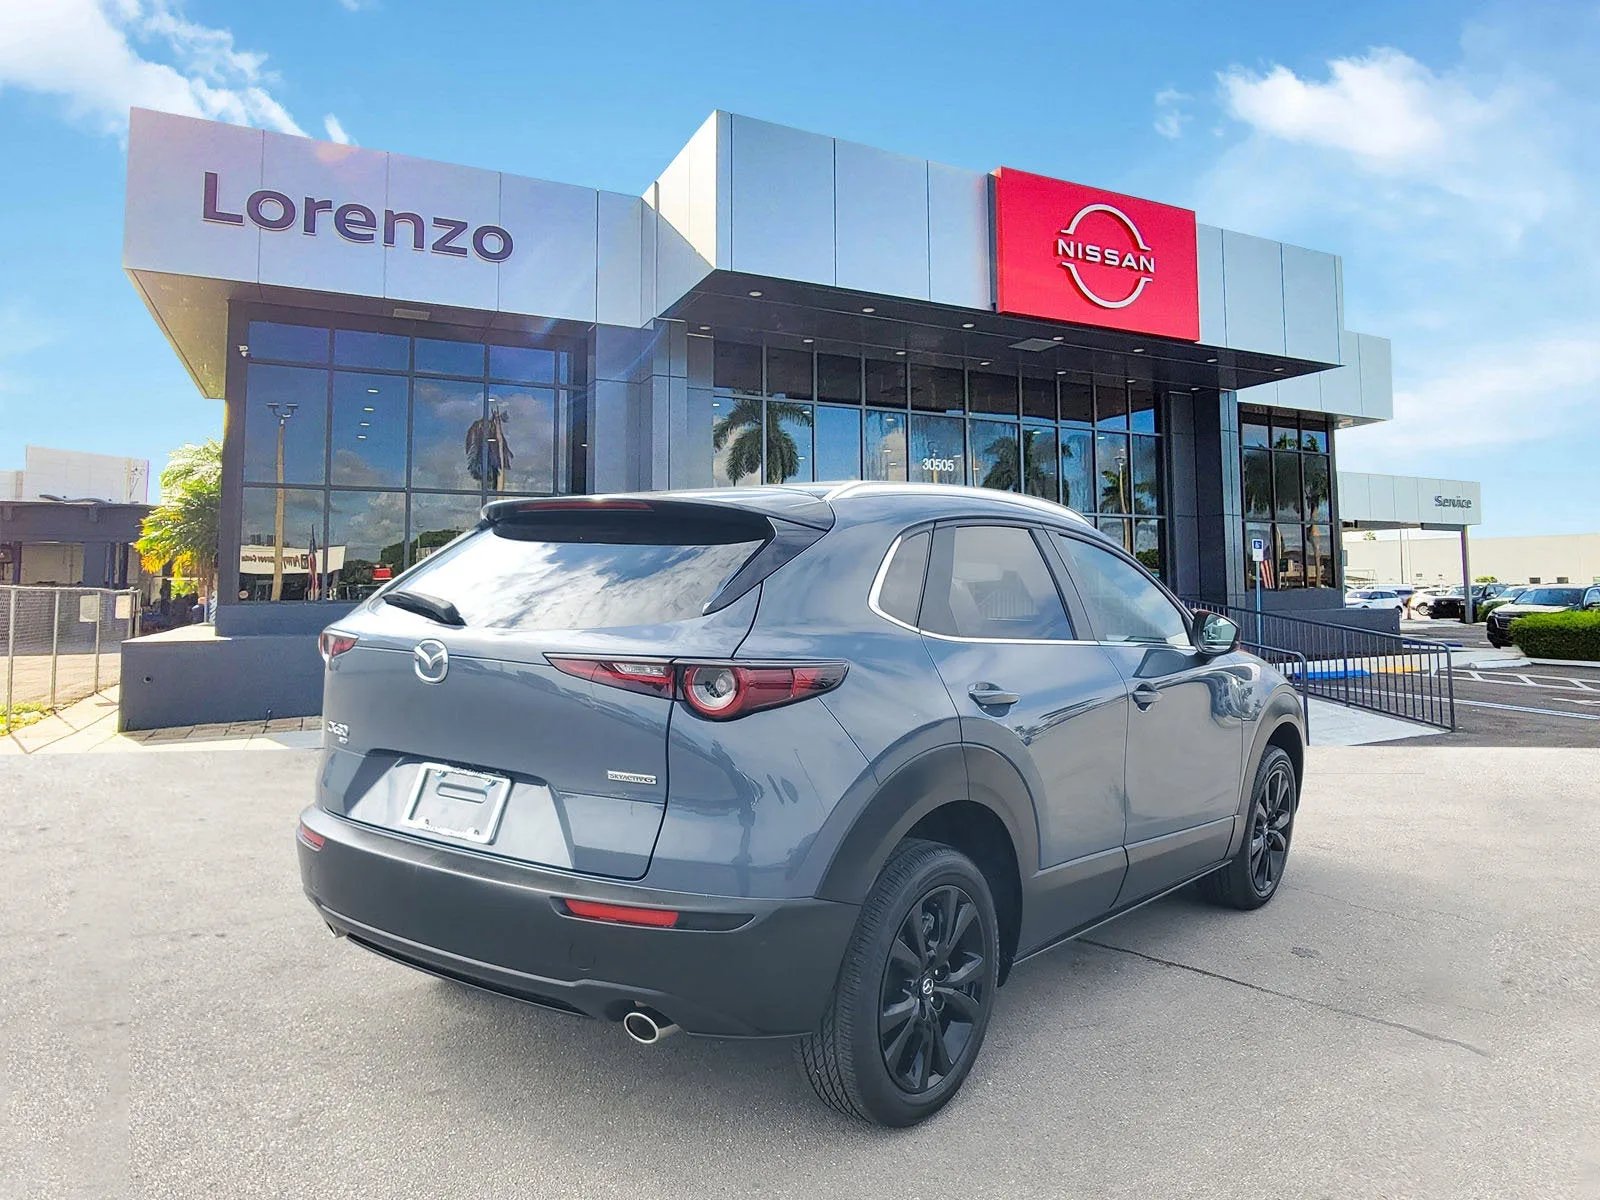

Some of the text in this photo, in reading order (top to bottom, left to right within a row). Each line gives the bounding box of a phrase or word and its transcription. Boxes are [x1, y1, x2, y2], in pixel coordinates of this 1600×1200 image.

[202, 170, 515, 263] Lorenzo
[1057, 238, 1155, 273] NISSAN
[922, 458, 955, 472] 30505
[1434, 495, 1472, 509] Service
